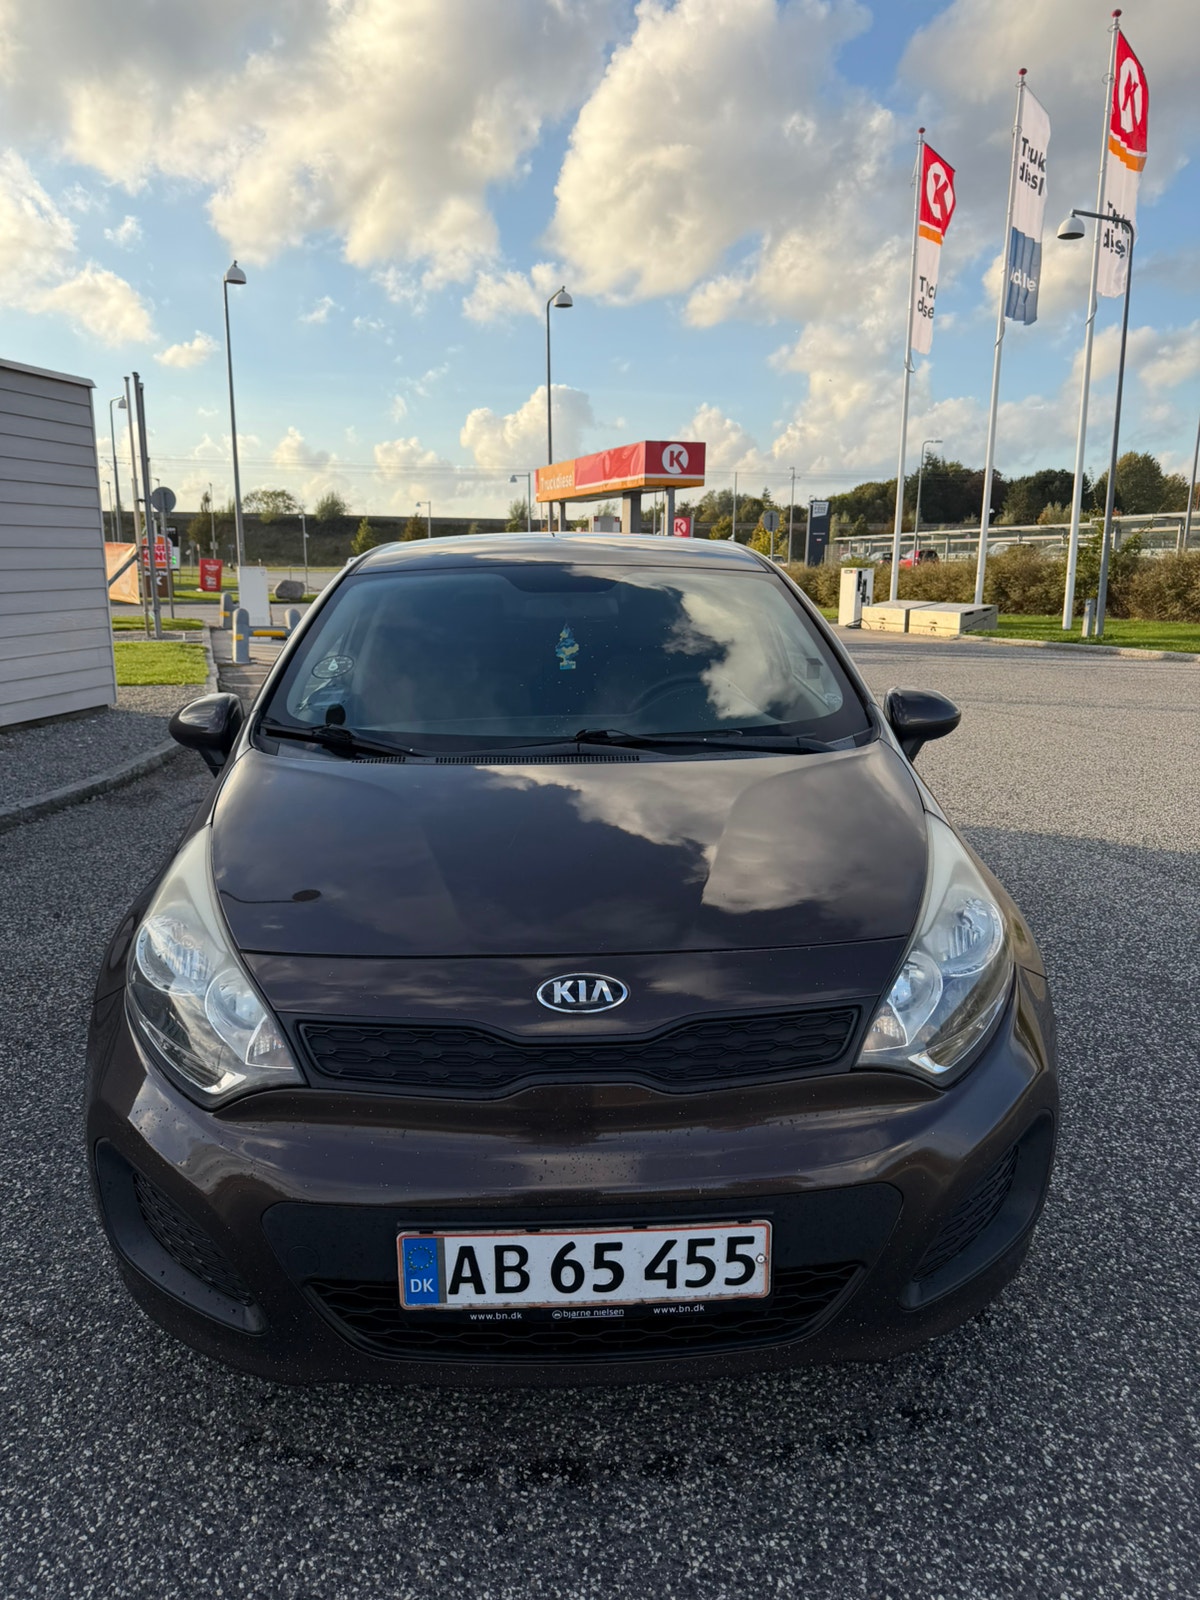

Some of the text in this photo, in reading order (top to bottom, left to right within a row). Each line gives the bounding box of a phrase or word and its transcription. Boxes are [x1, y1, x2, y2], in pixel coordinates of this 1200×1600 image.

[541, 471, 574, 491] Truckdiesel
[553, 980, 614, 1003] KIA
[447, 1236, 756, 1295] AB 65 455
[410, 1278, 434, 1293] DK
[470, 1312, 523, 1321] www.bn.dk
[563, 1307, 625, 1319] bjarne nielsen
[653, 1304, 705, 1314] www.bn.dk
